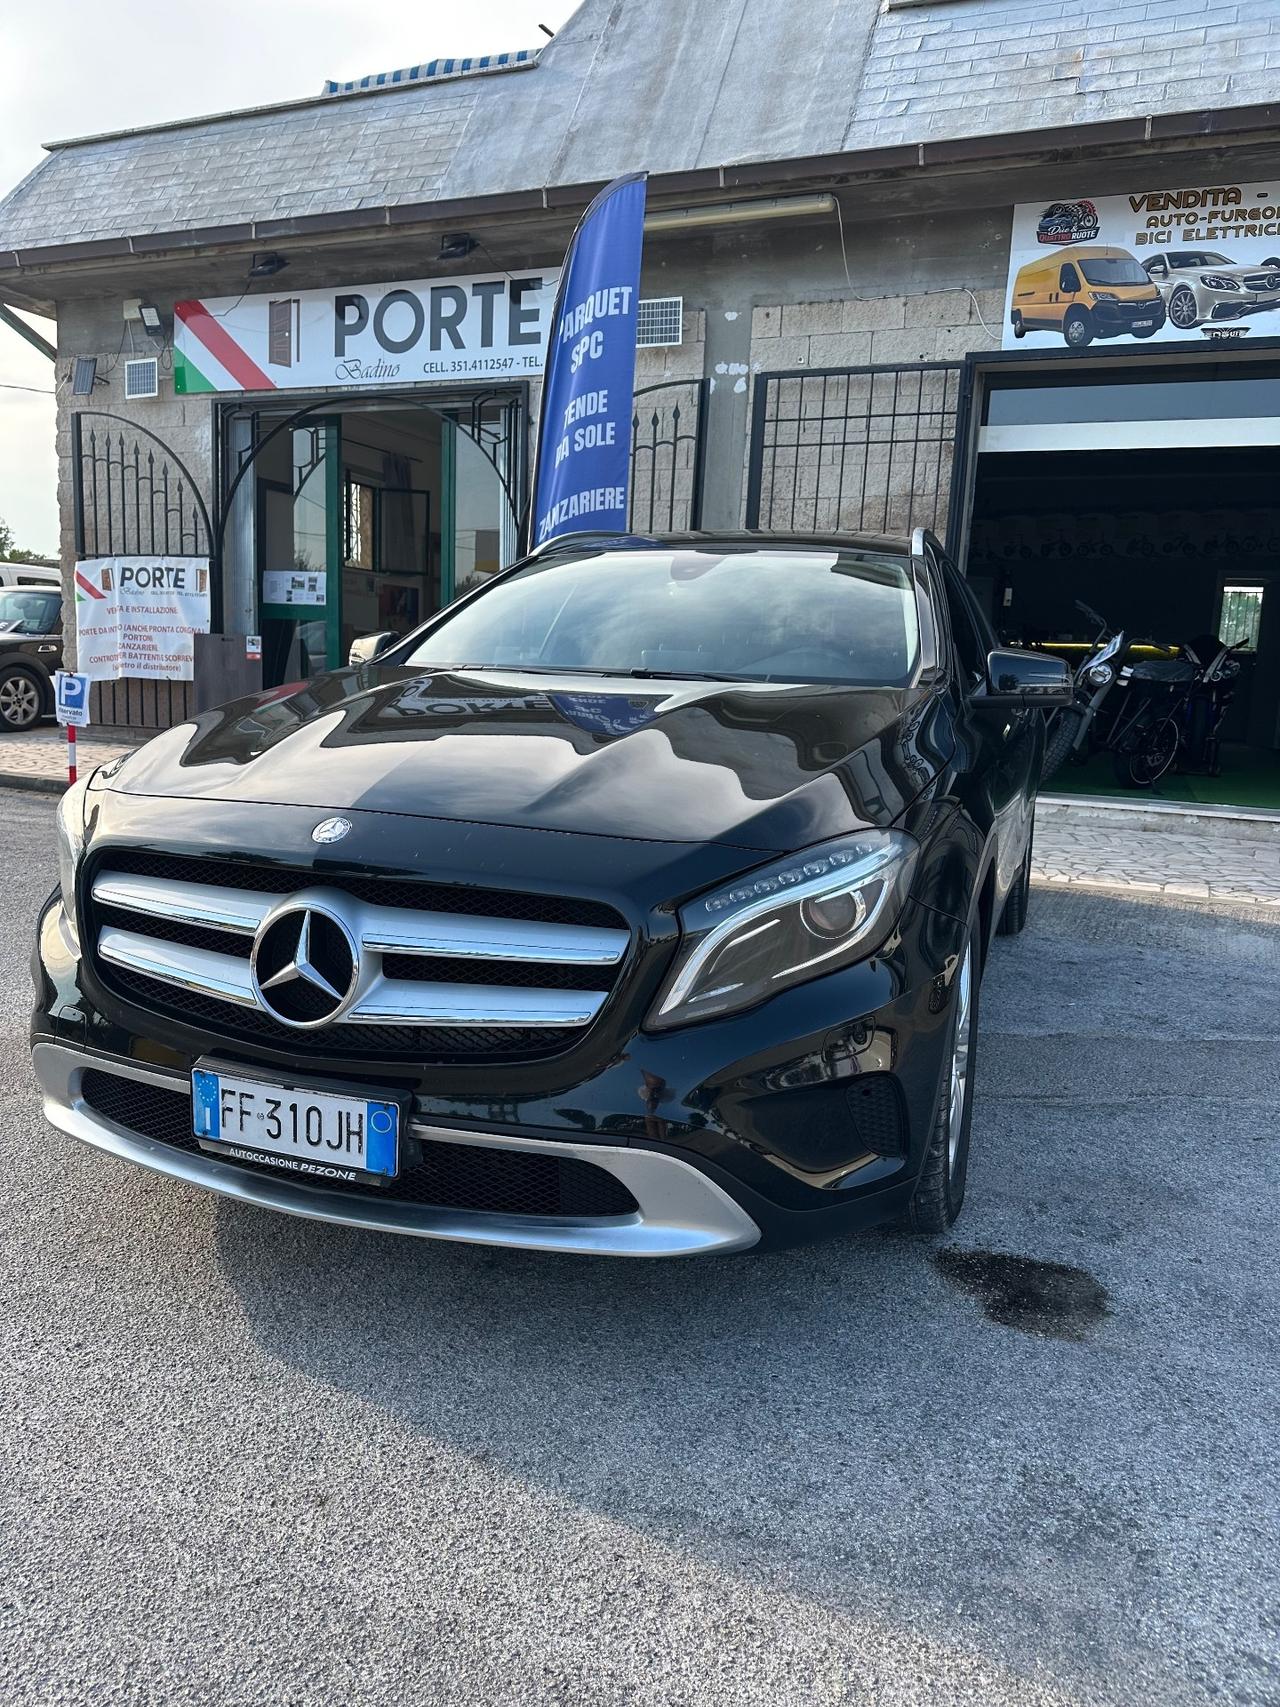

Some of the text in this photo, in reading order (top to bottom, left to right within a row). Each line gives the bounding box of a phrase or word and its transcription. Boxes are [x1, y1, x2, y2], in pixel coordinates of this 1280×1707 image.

[1129, 187, 1242, 213] VENDITA
[1040, 230, 1096, 241] QUATTRO RUOTE
[1135, 222, 1280, 246] BICI ELETTRIC
[335, 277, 543, 357] PORTE
[570, 330, 604, 374] SPC
[335, 358, 400, 380] Badino
[423, 361, 448, 374] CELL.
[451, 358, 514, 372] 351.4112547
[522, 356, 543, 368] TEL.
[564, 389, 608, 430] TENDE
[574, 422, 616, 452] SOLE
[539, 487, 625, 543] ZANZARIERE
[120, 567, 186, 589] PORTE
[131, 606, 178, 615] INSTALLAZIONE
[149, 625, 174, 633] PRONTA
[61, 676, 82, 705] P
[229, 1148, 356, 1180] AUTOCCASIONE PEZONE
